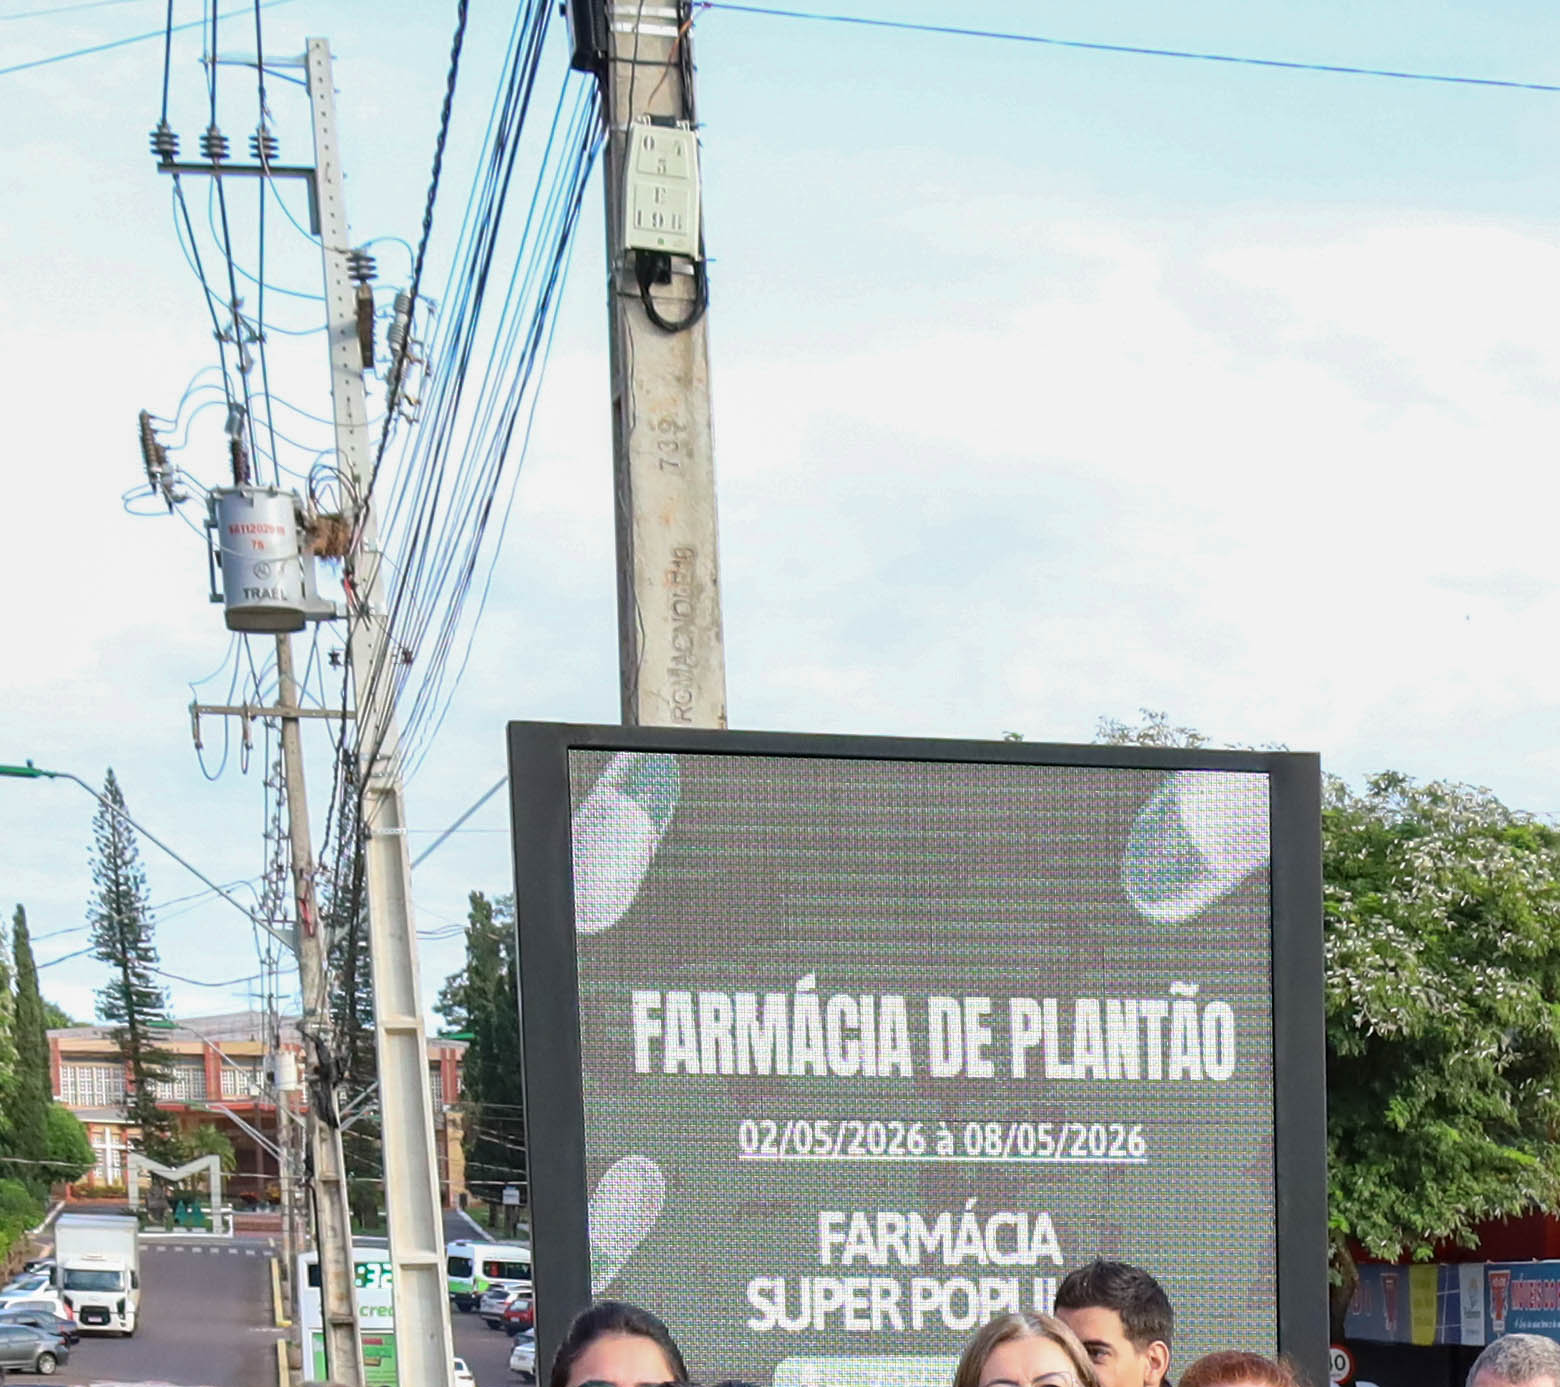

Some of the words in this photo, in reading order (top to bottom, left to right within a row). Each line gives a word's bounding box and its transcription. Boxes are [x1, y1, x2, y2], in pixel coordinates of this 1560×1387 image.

[632, 973, 913, 1078] FARMÁCIA
[928, 996, 995, 1078] DE
[1011, 981, 1236, 1080] PLANTÃO
[739, 1120, 924, 1158] 02/05/2026
[938, 1121, 953, 1156] à
[964, 1124, 1146, 1159] 08/05/2026
[819, 1197, 1064, 1266] FARMÁCIA
[747, 1275, 904, 1332] SUPER
